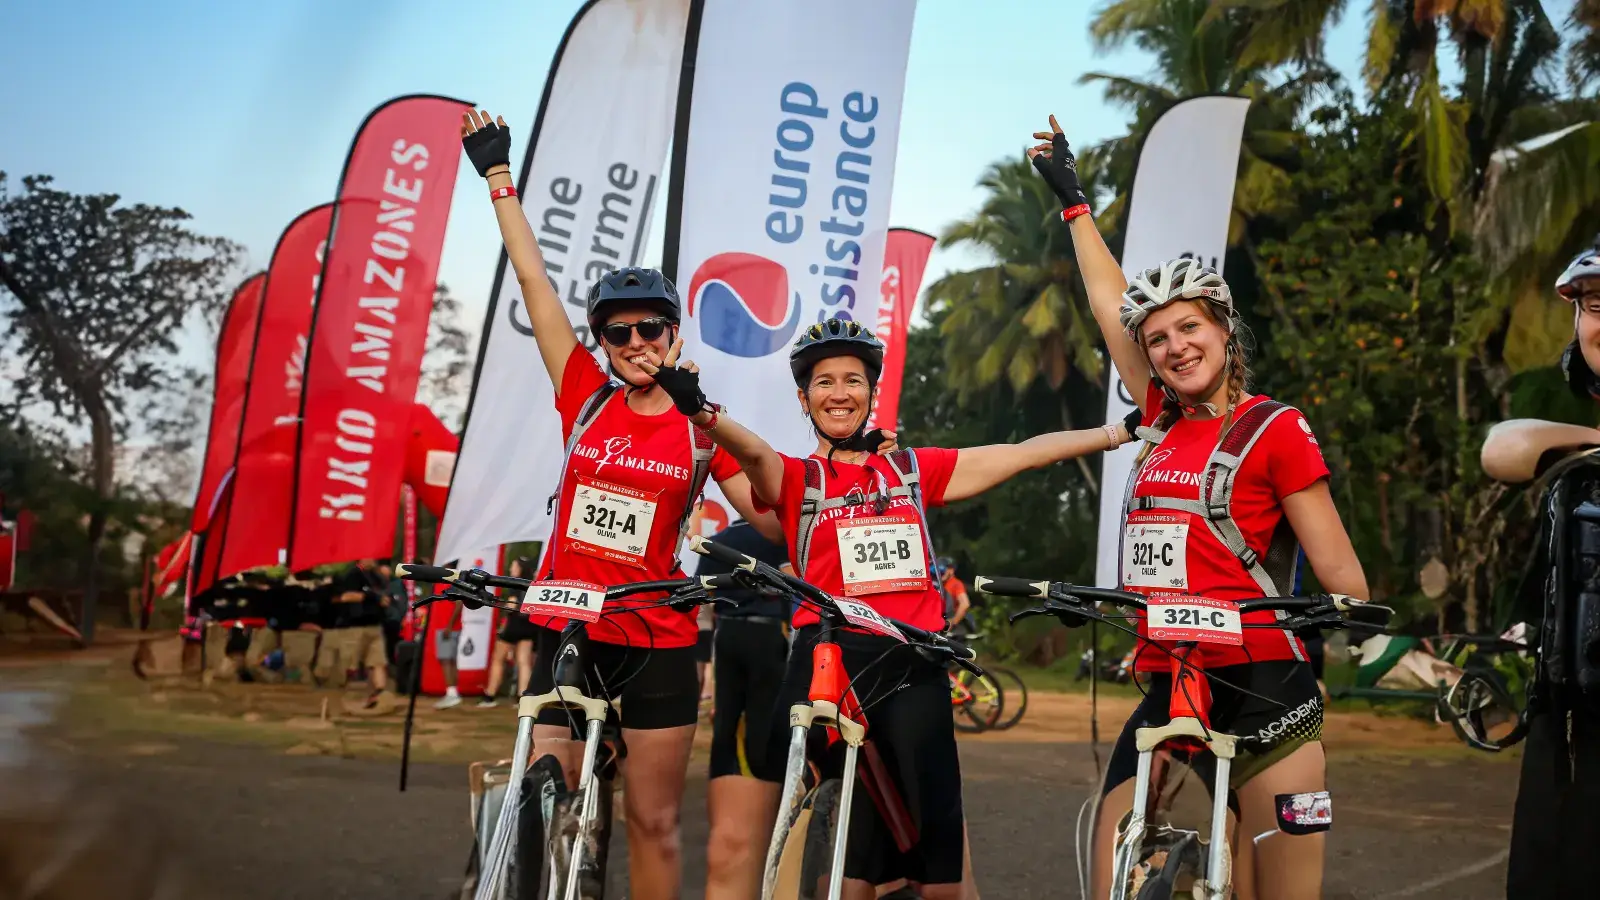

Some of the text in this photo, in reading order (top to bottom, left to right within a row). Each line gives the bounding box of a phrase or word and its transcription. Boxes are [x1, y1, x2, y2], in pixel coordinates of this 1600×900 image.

[766, 81, 829, 244] europ
[347, 138, 430, 393] AMAZONES
[615, 455, 689, 481] AMAZONES
[1144, 469, 1202, 486] AMAZON
[583, 503, 637, 535] 321-A
[596, 528, 617, 540] OLIVIA
[853, 539, 911, 564] 321-B
[1132, 542, 1174, 568] 321-C
[874, 562, 896, 571] AGNES
[538, 588, 589, 607] 321-A
[1164, 608, 1226, 628] 321-C
[1258, 696, 1319, 739] ACADEMY
